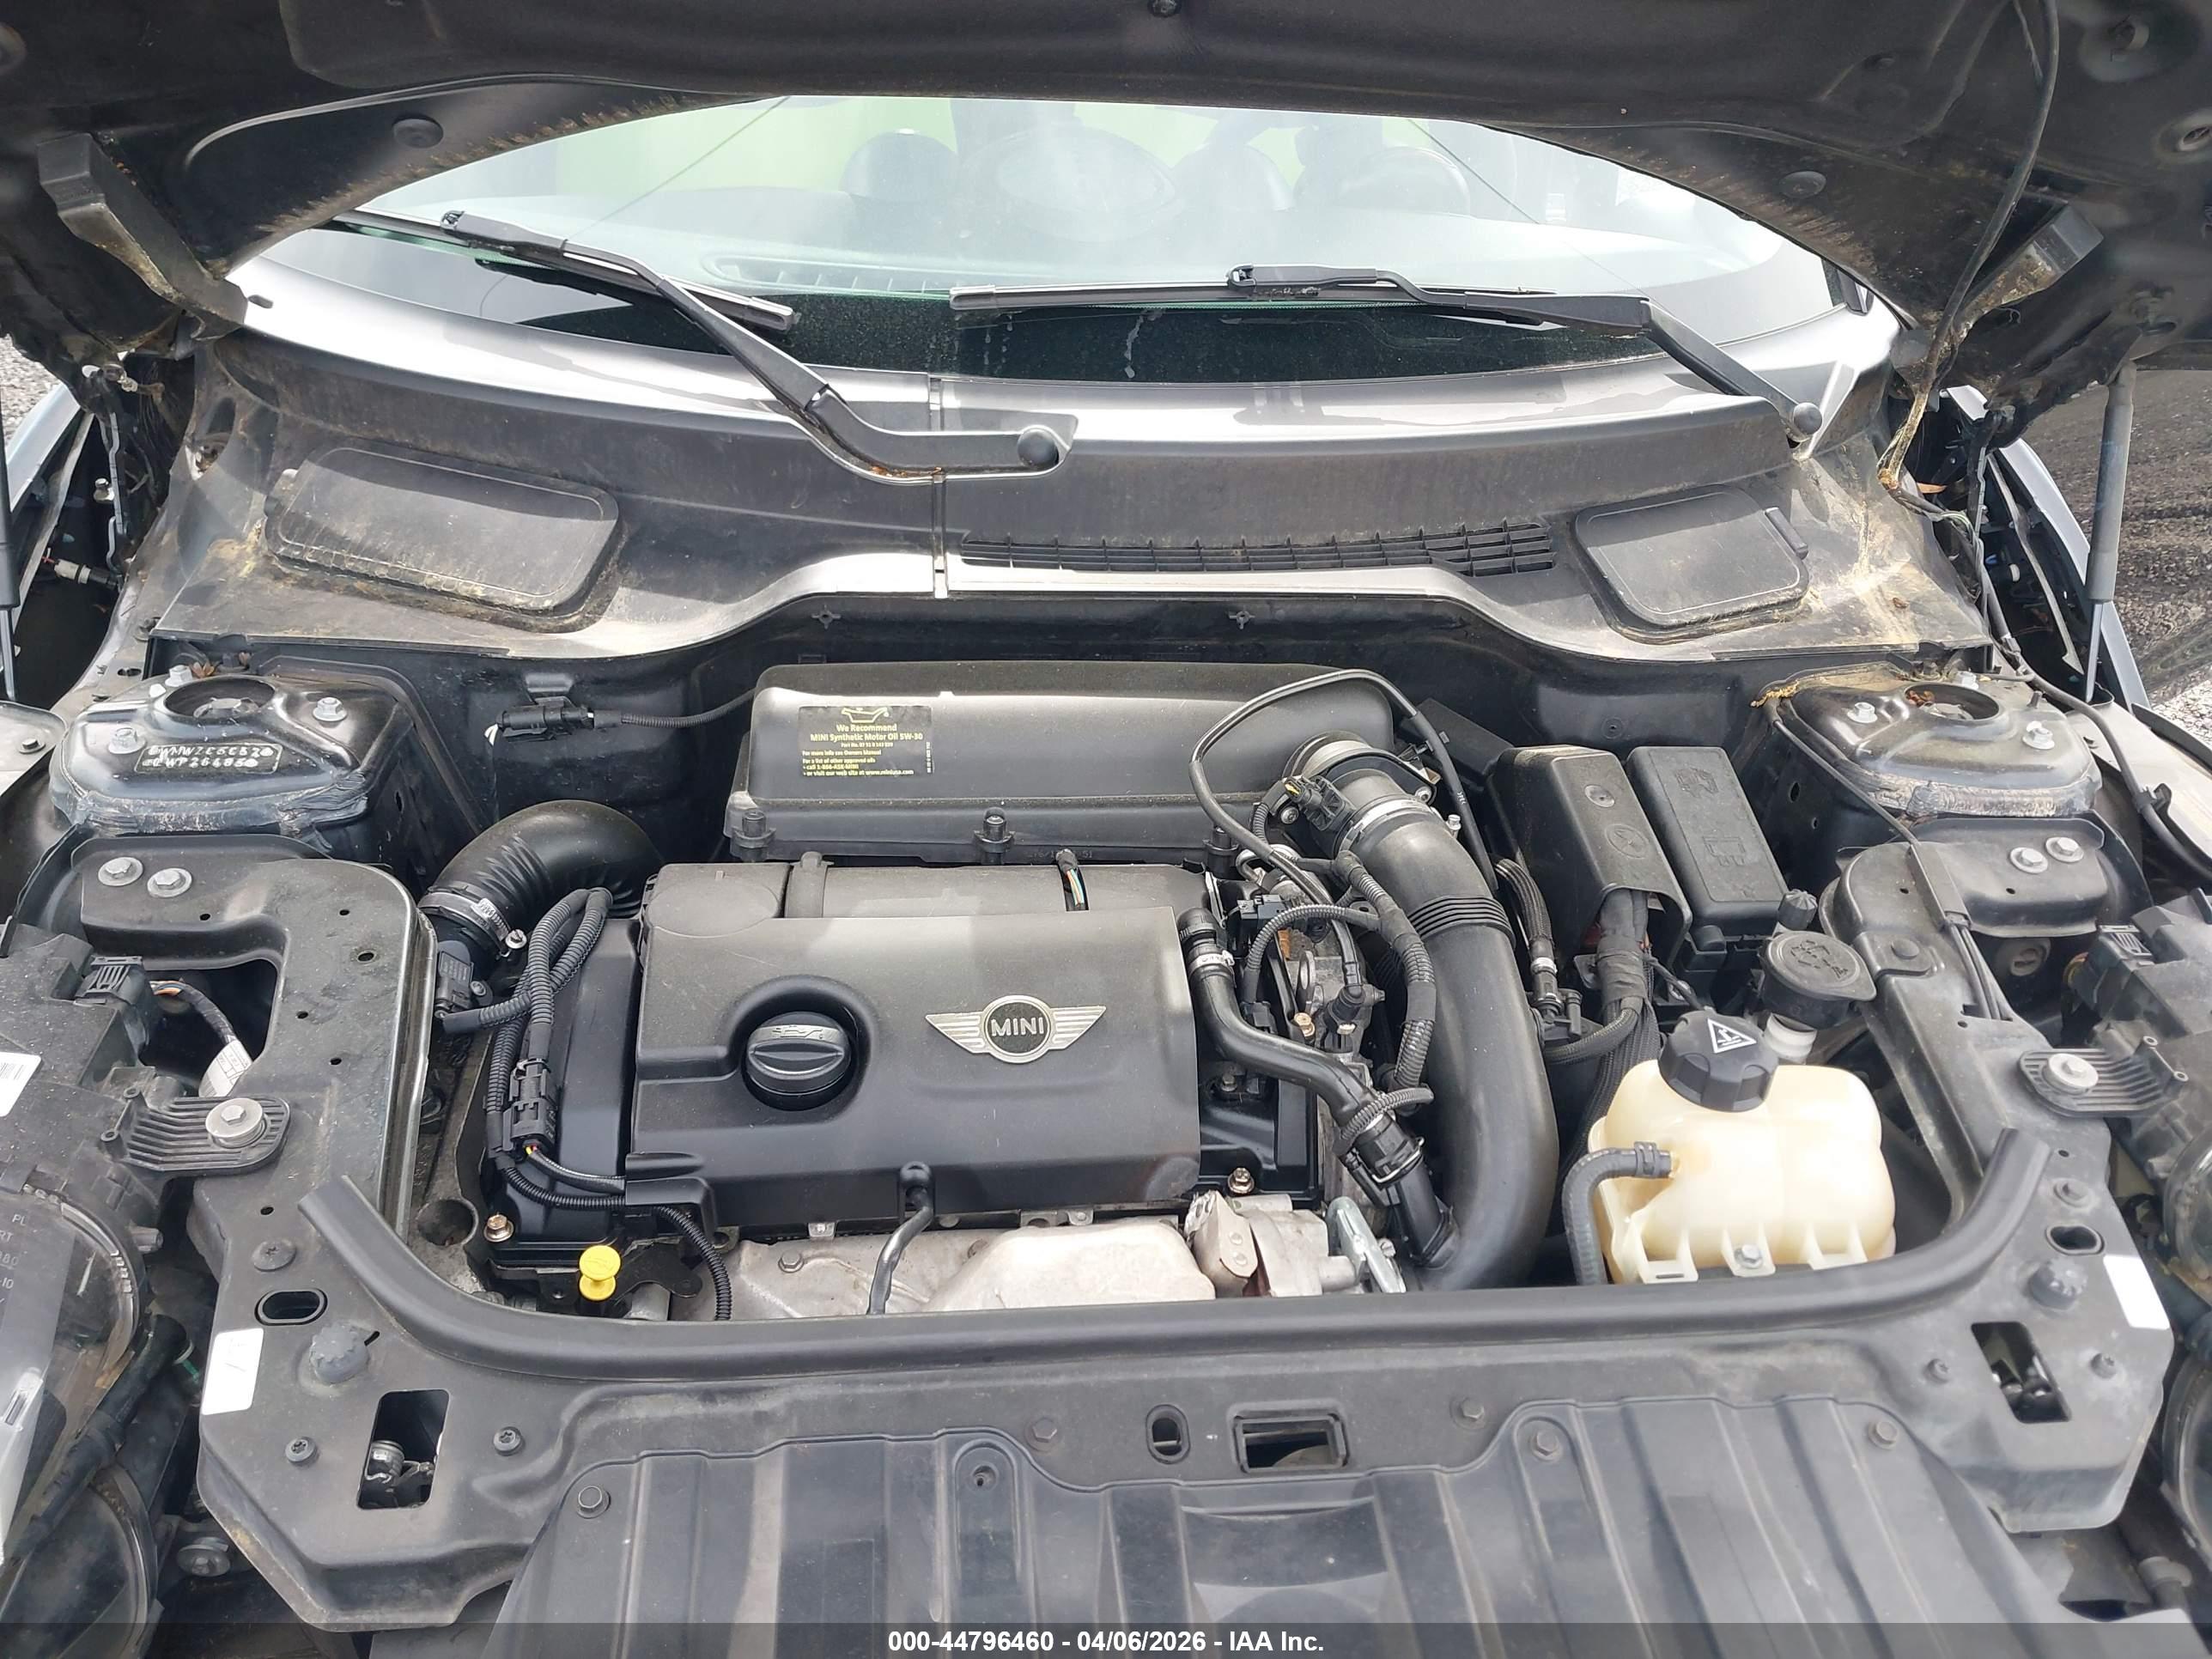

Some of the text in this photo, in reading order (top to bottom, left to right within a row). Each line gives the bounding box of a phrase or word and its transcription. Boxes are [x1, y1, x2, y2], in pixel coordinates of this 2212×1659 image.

[836, 724, 897, 732] We Recommend
[830, 733, 864, 743] Synthetic
[864, 732, 886, 741] Motor
[991, 1017, 1045, 1036] MINI
